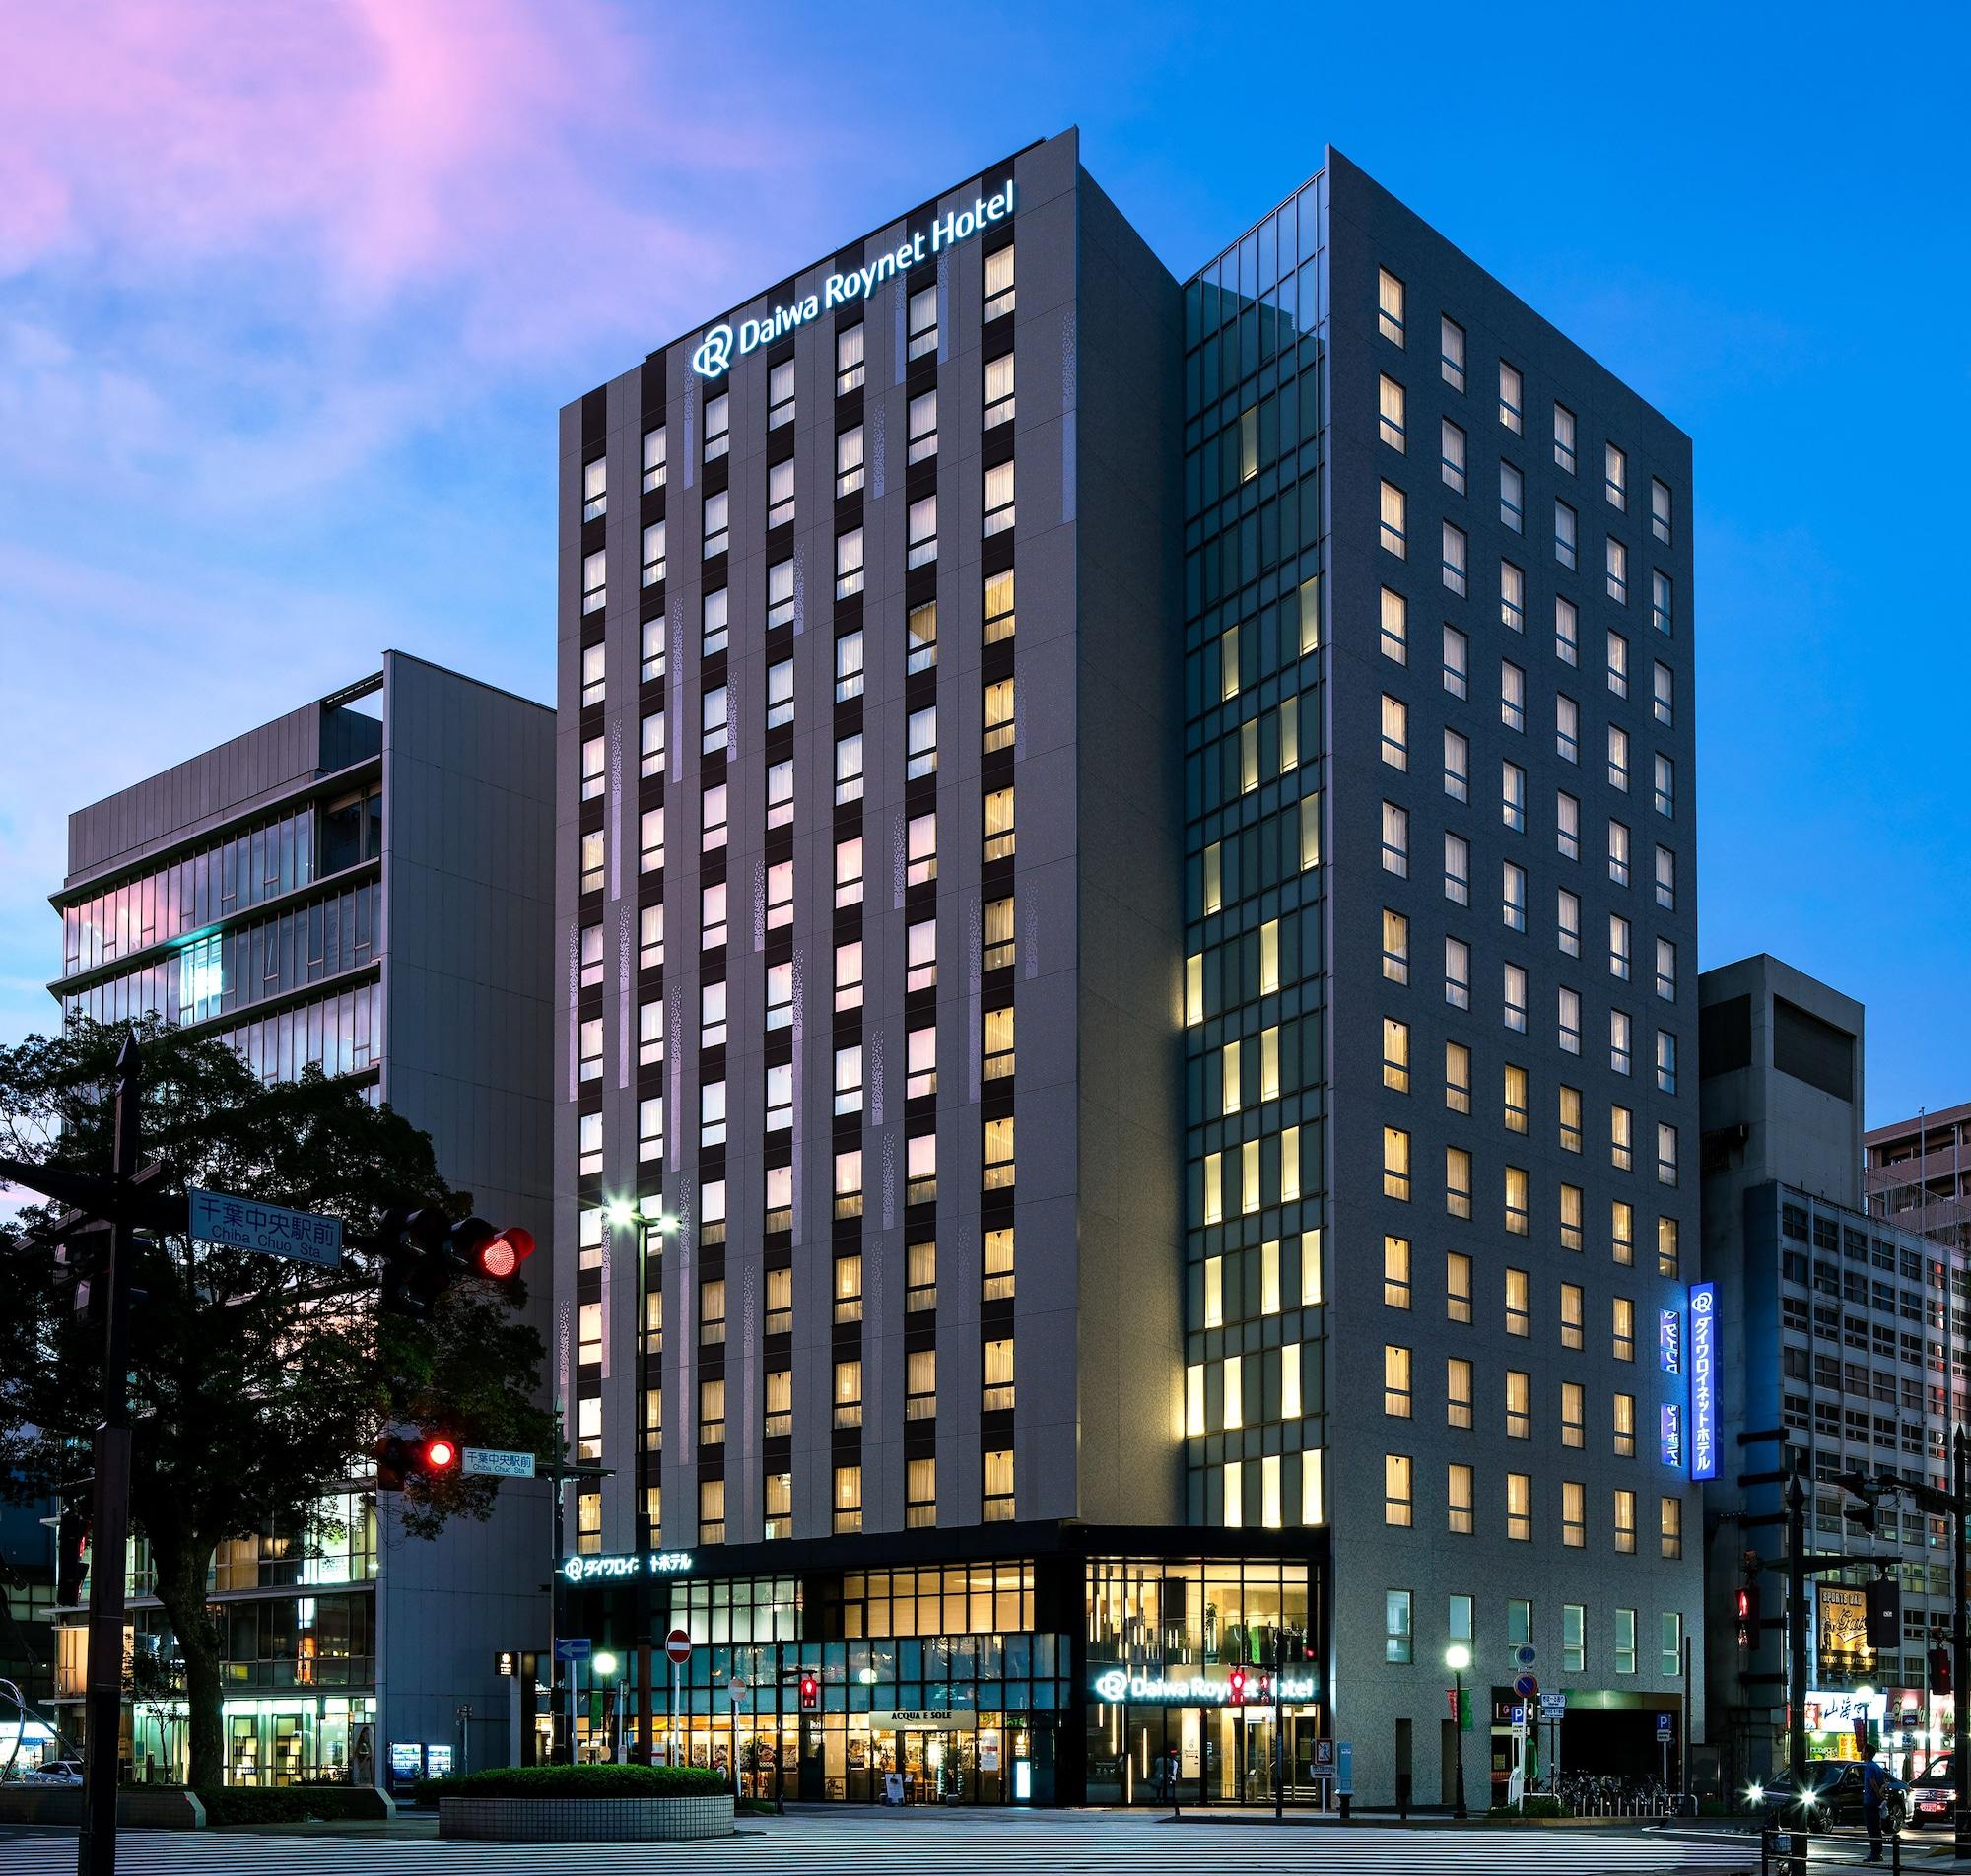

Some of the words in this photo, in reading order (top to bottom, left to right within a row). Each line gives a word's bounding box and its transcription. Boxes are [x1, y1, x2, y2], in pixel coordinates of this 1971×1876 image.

[740, 295, 818, 355] Daiwa
[825, 232, 926, 310] Roynet
[932, 179, 1014, 252] Hotel
[199, 1197, 334, 1247] 千葉中央駅前
[212, 1225, 250, 1243] Chiba
[257, 1234, 292, 1252] Chuo
[300, 1242, 323, 1259] Sta.
[1694, 1316, 1712, 1471] ダイワロイネットホテル
[467, 1451, 531, 1468] 千葉中央駅前
[1822, 1592, 1848, 1604] SPORTS
[1131, 1678, 1189, 1697] Daiwa
[891, 1712, 920, 1721] ACQUA
[1515, 1708, 1523, 1721] P
[1660, 1716, 1667, 1729] P
